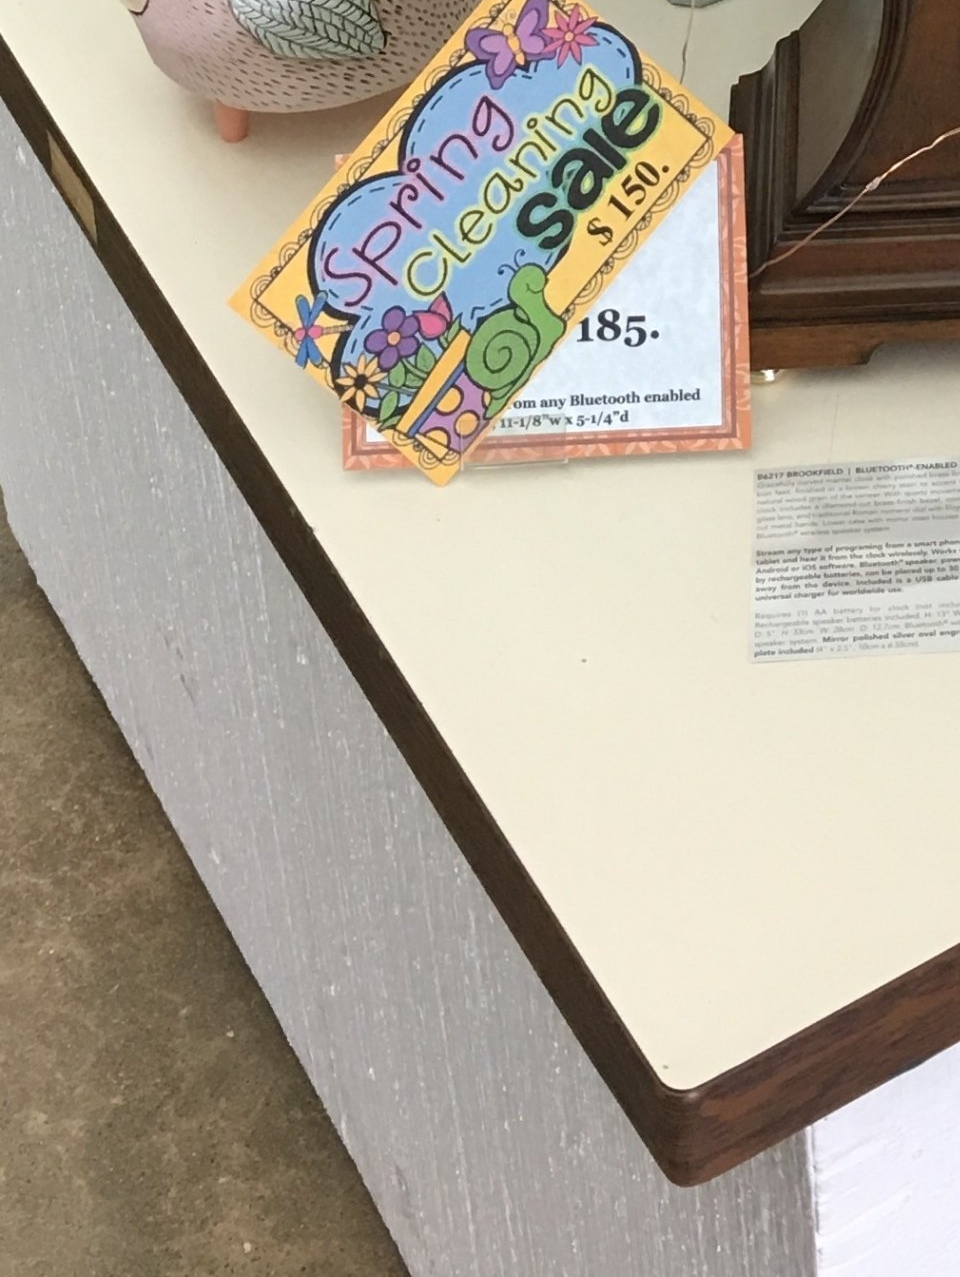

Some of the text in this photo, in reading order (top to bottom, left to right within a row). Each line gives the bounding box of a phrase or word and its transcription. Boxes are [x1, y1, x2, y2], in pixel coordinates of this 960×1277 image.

[322, 95, 515, 308] Spring
[405, 66, 614, 299] Cleaning
[585, 161, 671, 246] $ 150.
[576, 308, 661, 347] 185.
[508, 389, 700, 411] om any Bluetooth enabled
[565, 416, 573, 425] x
[787, 468, 843, 478] BROOKFIELD
